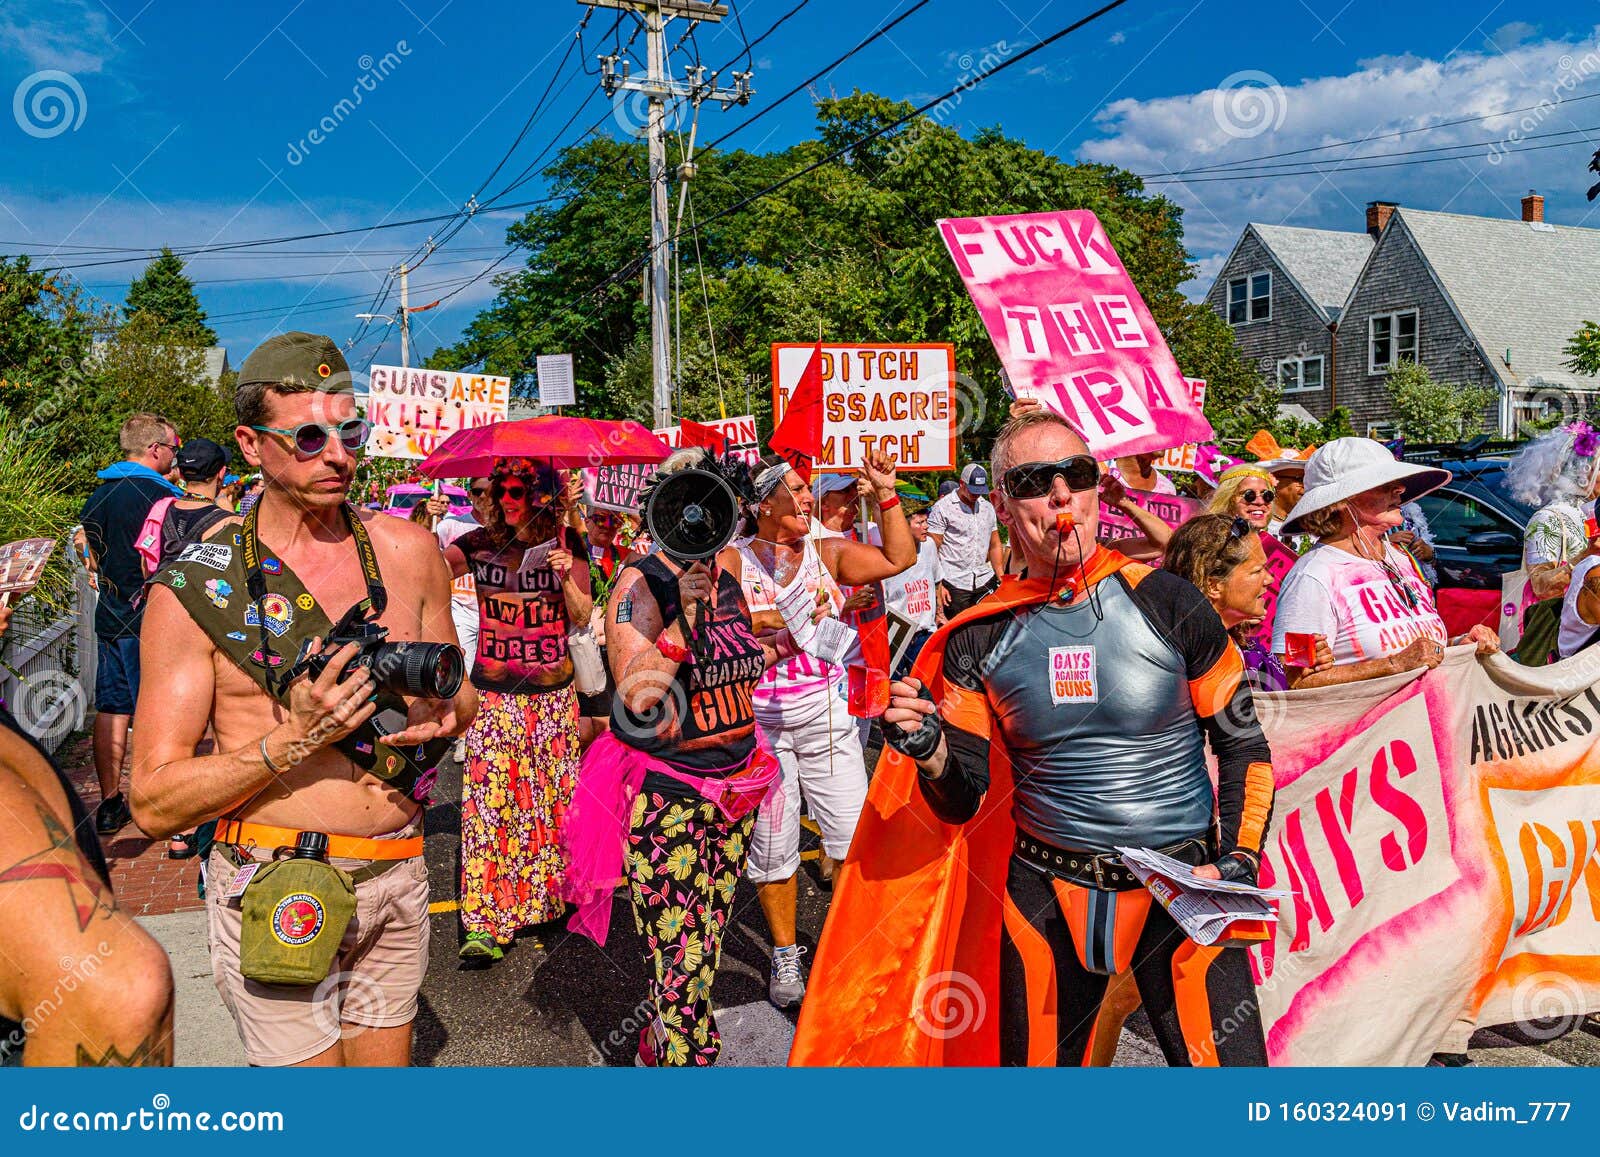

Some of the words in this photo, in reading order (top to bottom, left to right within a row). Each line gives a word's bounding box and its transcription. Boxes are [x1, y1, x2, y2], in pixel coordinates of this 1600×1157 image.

[940, 214, 1121, 277] FUCK
[1007, 301, 1142, 354] THE
[371, 369, 447, 398] GUNS
[450, 376, 507, 404] ARE
[475, 563, 504, 584] NO
[904, 578, 929, 593] GAYS
[488, 602, 514, 623] IN
[908, 600, 931, 614] GUNS
[690, 621, 763, 664] AYS
[1054, 652, 1090, 670] GAYS
[690, 655, 765, 690] AGAINS
[1055, 670, 1089, 681] AGAINST
[1055, 680, 1093, 697] GUNS
[1471, 686, 1600, 765] AGAINS
[1151, 877, 1174, 899] VOTE
